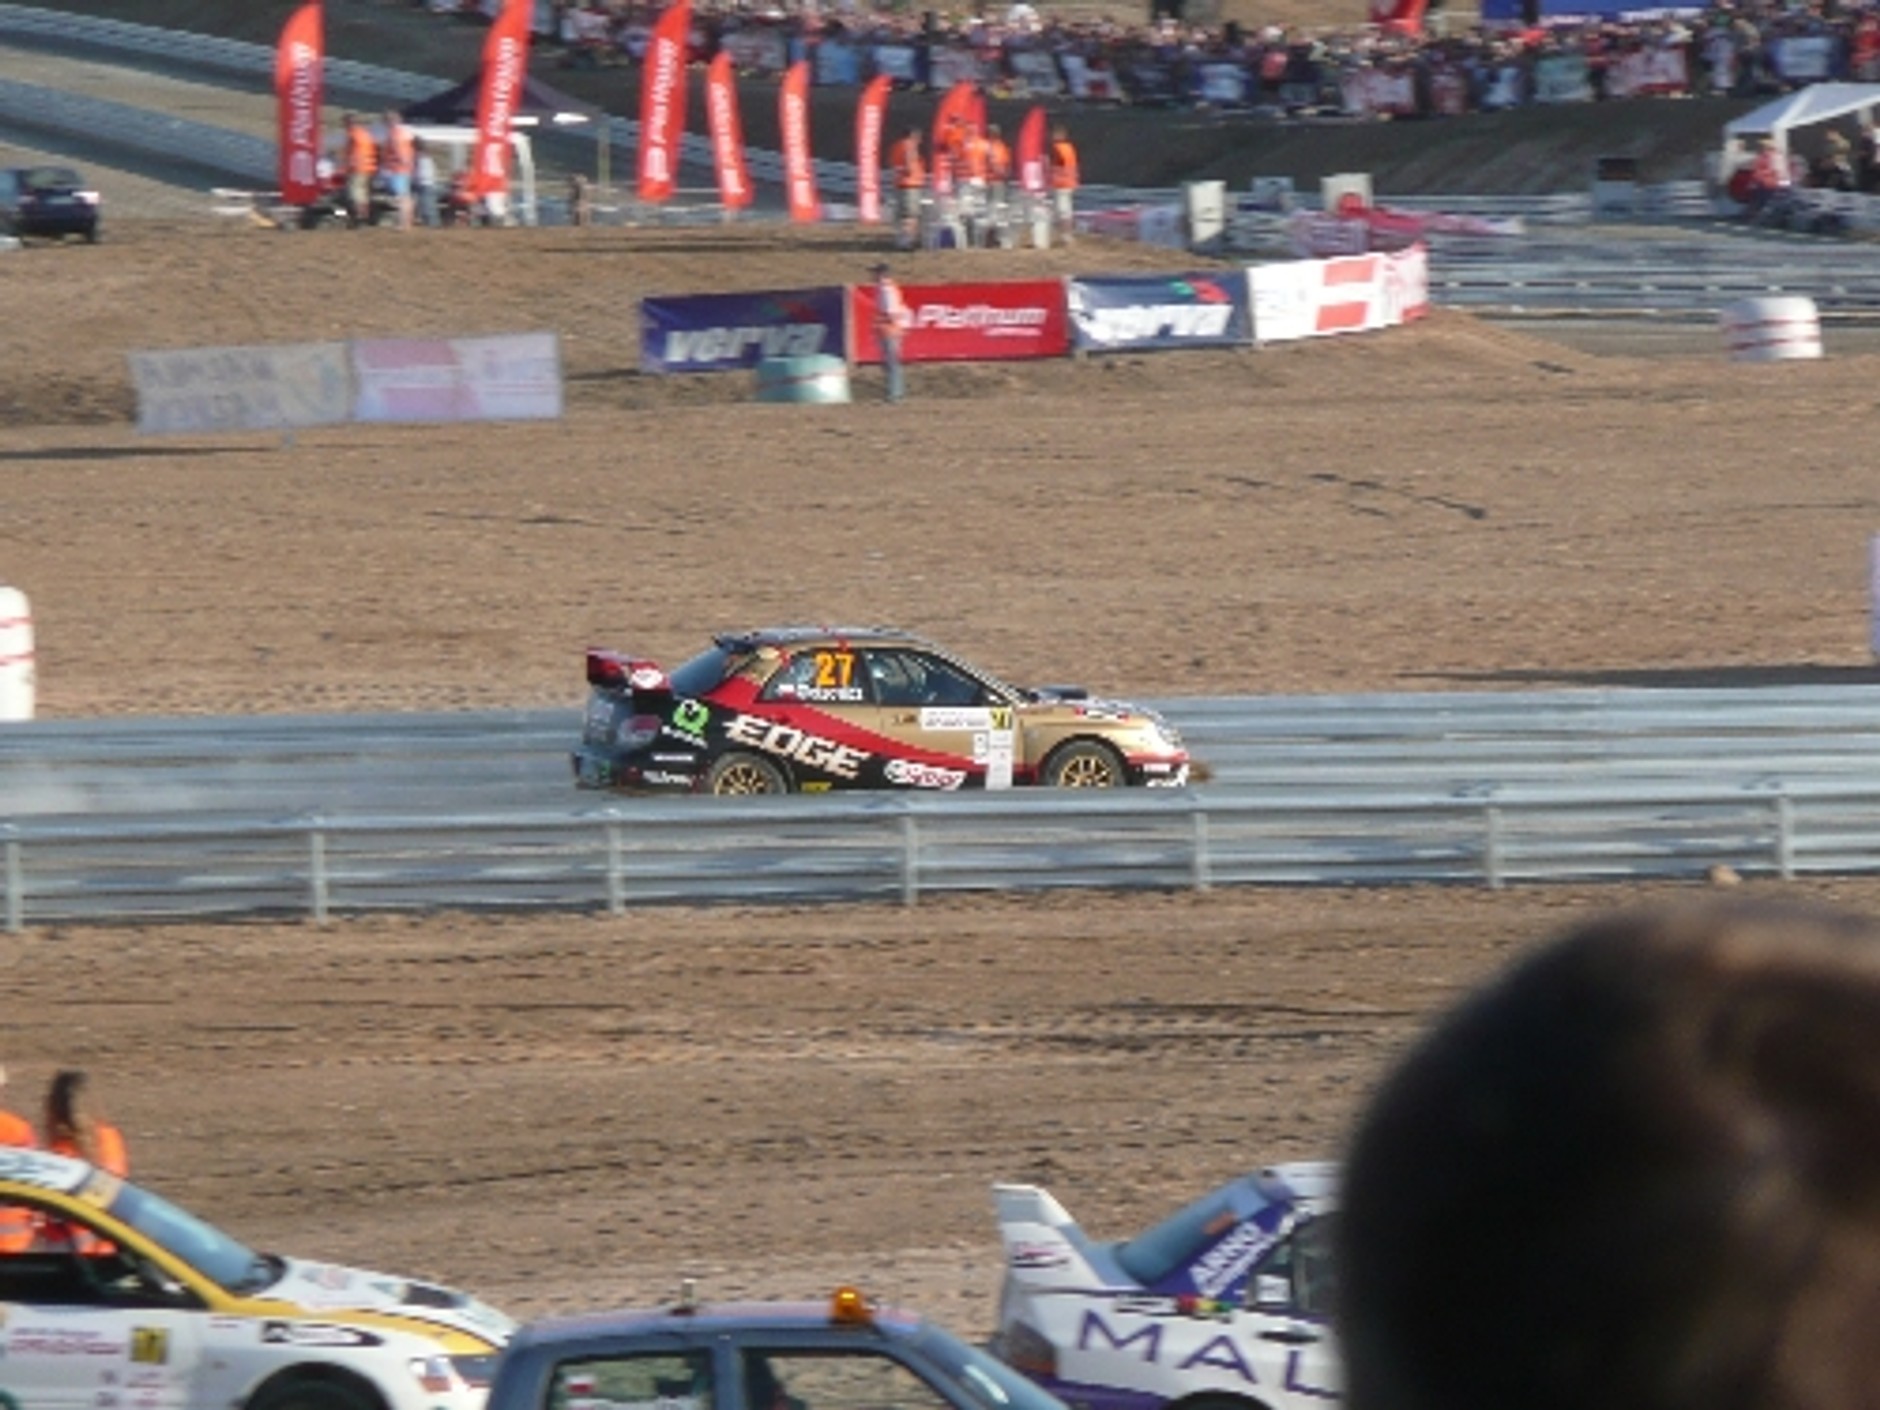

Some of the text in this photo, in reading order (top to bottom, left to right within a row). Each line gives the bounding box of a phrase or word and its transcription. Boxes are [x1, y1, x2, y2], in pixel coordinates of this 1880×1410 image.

[664, 323, 827, 363] verva
[816, 651, 855, 687] 27
[722, 714, 872, 780] EDGE
